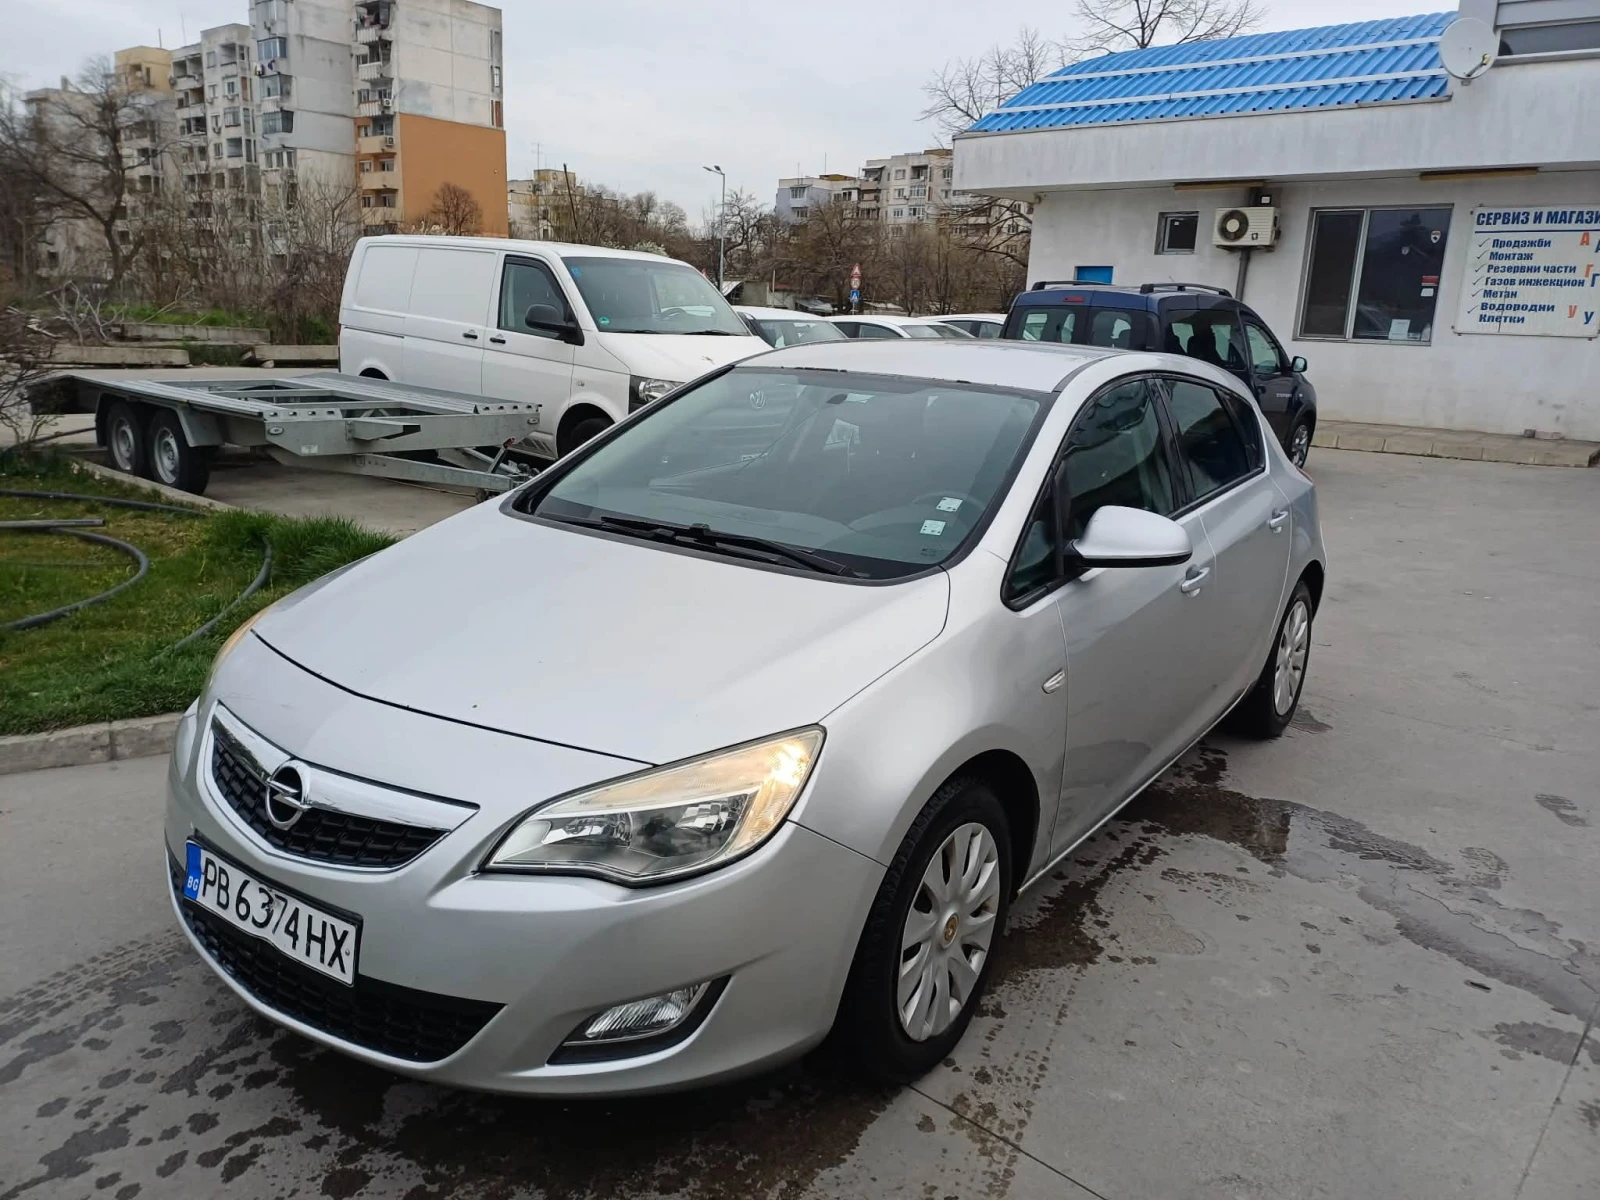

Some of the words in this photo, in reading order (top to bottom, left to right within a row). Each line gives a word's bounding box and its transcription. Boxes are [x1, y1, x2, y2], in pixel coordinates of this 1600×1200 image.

[1476, 211, 1530, 226] СЕРВИЗ
[1533, 211, 1543, 224] И
[1492, 238, 1551, 249] Продажби
[1489, 251, 1533, 261] Монтаж
[1487, 264, 1541, 274] Резервни
[1543, 265, 1576, 273] части
[1485, 276, 1516, 286] Газов
[1519, 278, 1585, 287] инжекцион
[1483, 289, 1517, 299] Метан
[1480, 302, 1555, 312] Водородни
[1478, 313, 1525, 324] Клетки
[187, 875, 199, 892] BG
